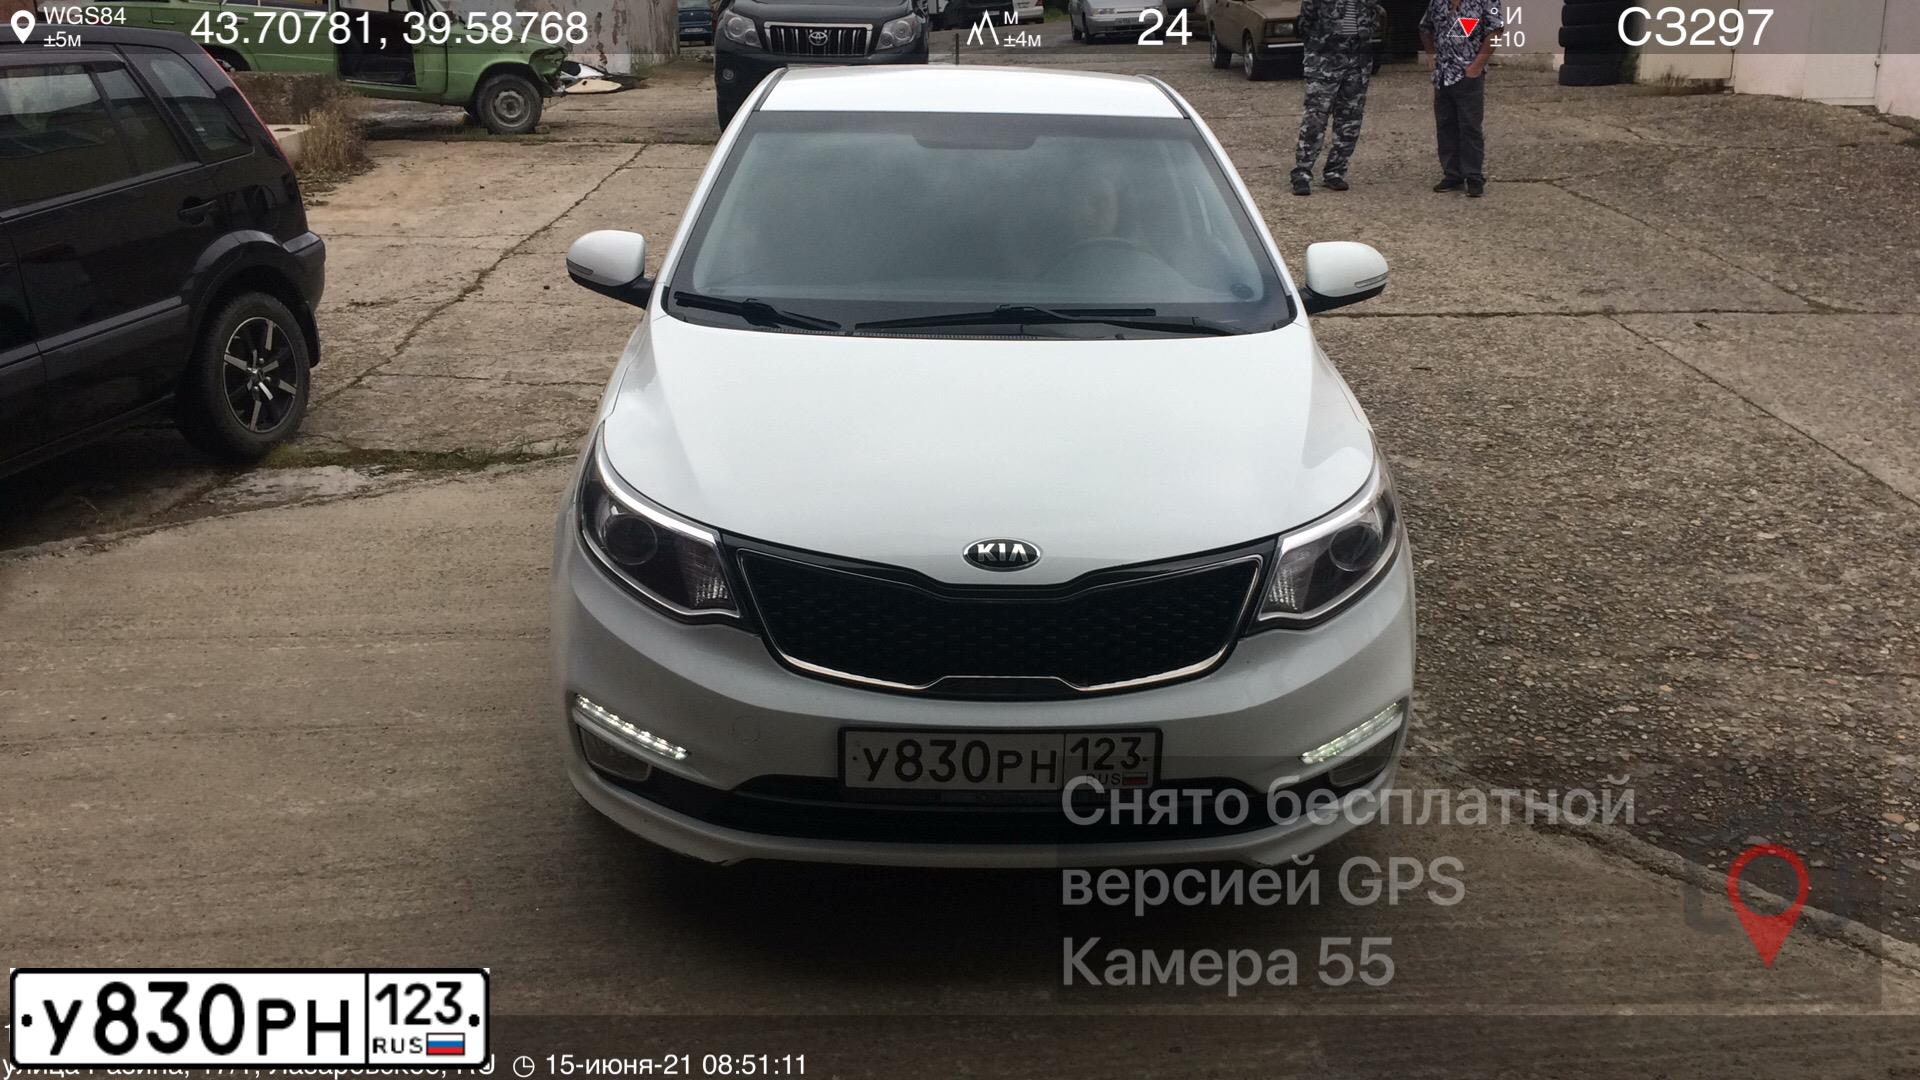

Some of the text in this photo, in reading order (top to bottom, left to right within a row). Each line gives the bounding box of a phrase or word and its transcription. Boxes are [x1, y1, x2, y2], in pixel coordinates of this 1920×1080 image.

[976, 542, 1029, 563] KIA
[1069, 736, 1142, 771] 123
[1085, 772, 1121, 786] RUS
